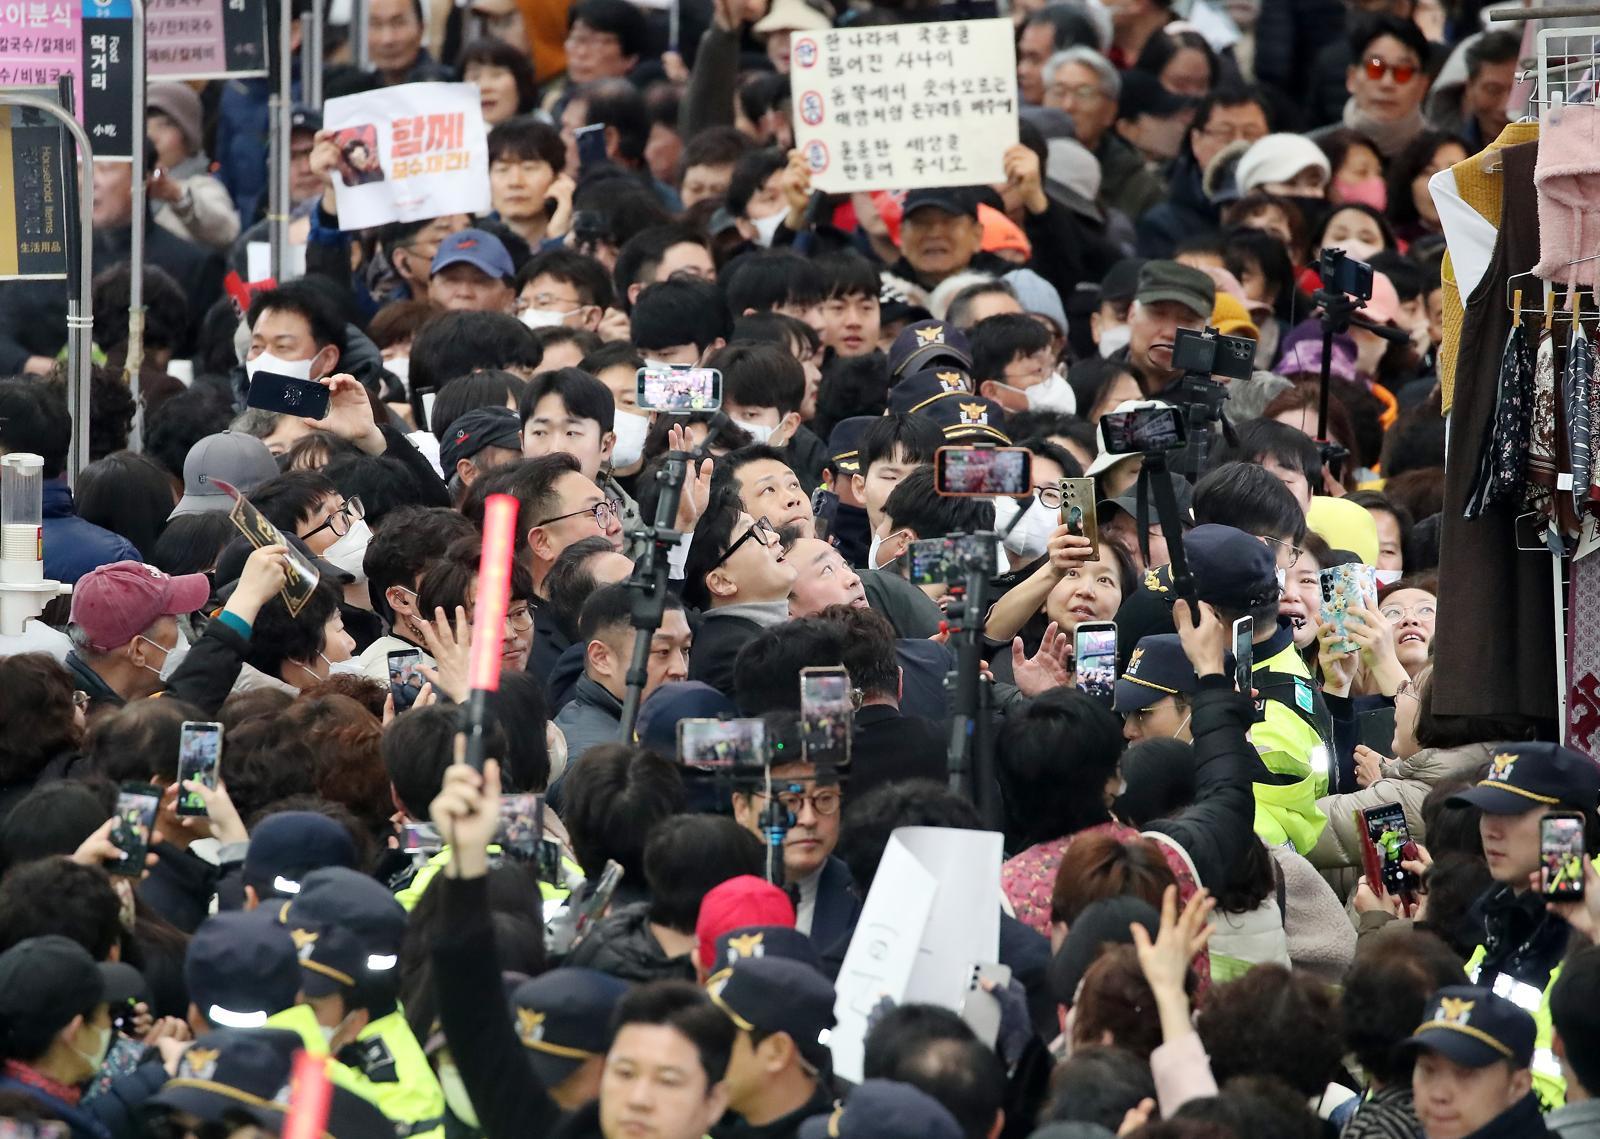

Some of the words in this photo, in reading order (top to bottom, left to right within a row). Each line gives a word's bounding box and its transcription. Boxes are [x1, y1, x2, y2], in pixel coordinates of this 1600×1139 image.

[0, 2, 72, 29] 이분식
[90, 34, 107, 91] 먹거리
[109, 35, 120, 63] Food
[896, 49, 953, 69] 사나이
[391, 111, 464, 159] 함께
[42, 146, 53, 203] Household
[914, 155, 967, 175] 주시오
[20, 241, 62, 253] 生活用品
